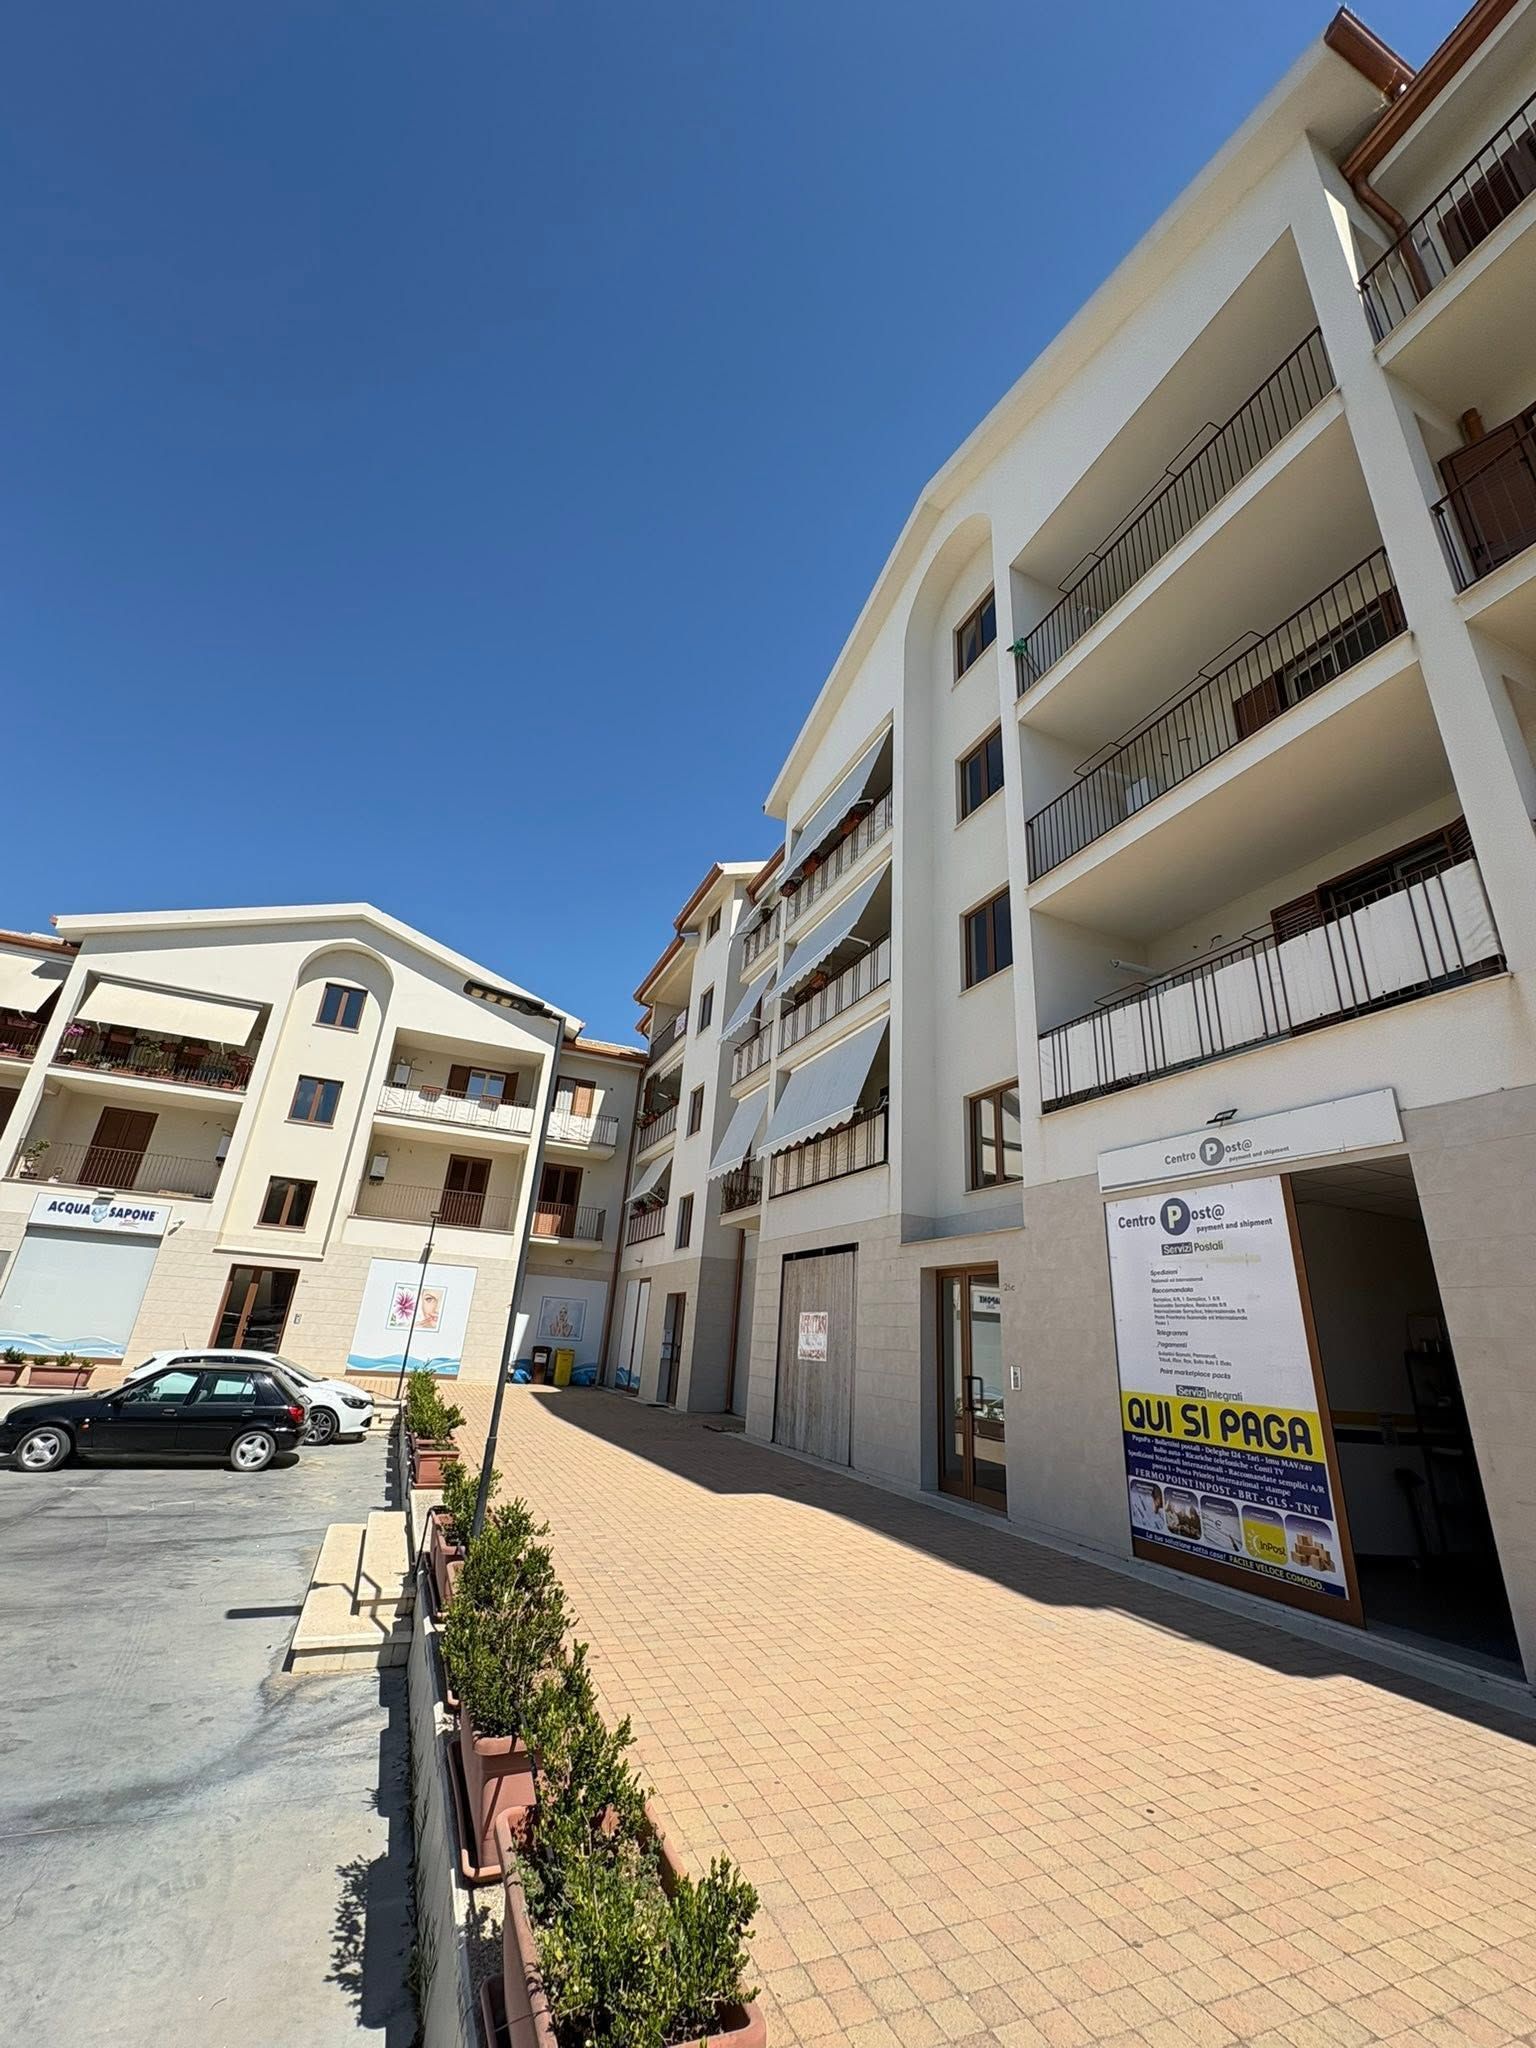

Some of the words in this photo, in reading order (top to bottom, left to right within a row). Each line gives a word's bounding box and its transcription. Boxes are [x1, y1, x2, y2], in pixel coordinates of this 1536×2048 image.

[1164, 1152, 1196, 1165] Centro
[1252, 1149, 1262, 1158] and
[1263, 1145, 1290, 1157] shipment
[48, 1201, 91, 1215] ACQUA
[108, 1206, 156, 1221] SAPONE
[1118, 1213, 1156, 1229] Centro
[1196, 1222, 1224, 1234] payment
[1225, 1219, 1238, 1229] and
[1239, 1217, 1273, 1230] shipment
[1162, 1243, 1192, 1255] Servizi
[1193, 1240, 1224, 1253] Postali
[1177, 1386, 1206, 1399] Servizi
[1207, 1390, 1243, 1402] Integrati
[1128, 1397, 1172, 1433] QUI
[1181, 1403, 1210, 1439] SI
[1220, 1408, 1313, 1456] PAGA
[1274, 1467, 1284, 1476] TV
[1228, 1468, 1277, 1484] Raccomandate
[1278, 1478, 1309, 1491] semplici
[1310, 1484, 1326, 1495] A/R
[1135, 1467, 1165, 1480] FERMO
[1165, 1474, 1195, 1487] POINT
[1195, 1481, 1231, 1496] INPOST
[1238, 1489, 1259, 1502] BRT
[1266, 1496, 1288, 1508] GLS
[1295, 1501, 1320, 1516] TNT
[1265, 1484, 1291, 1497] stampe
[1256, 1562, 1284, 1578] VELOCE
